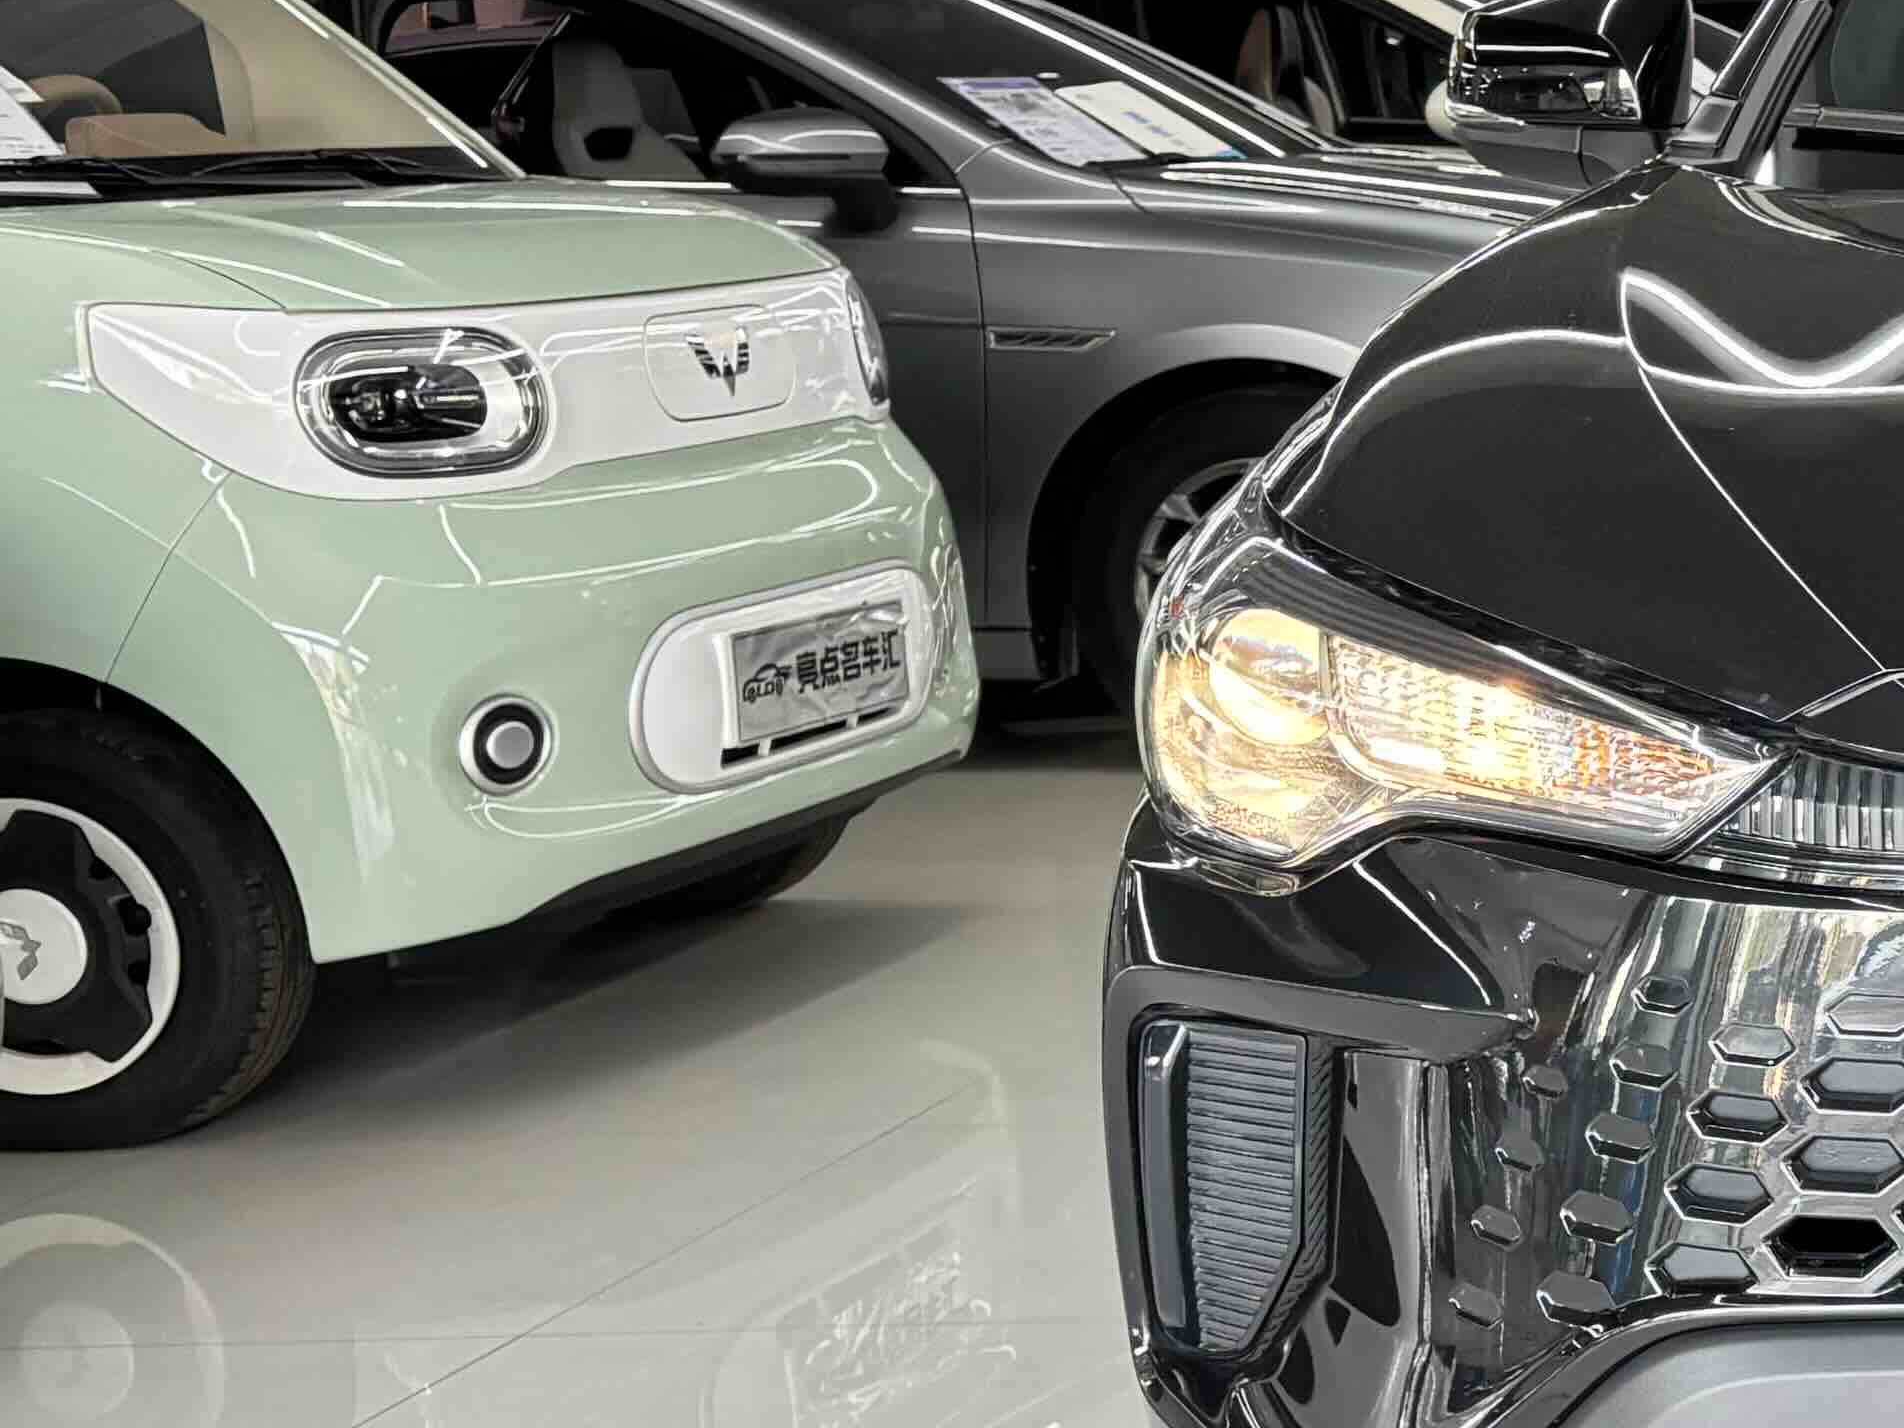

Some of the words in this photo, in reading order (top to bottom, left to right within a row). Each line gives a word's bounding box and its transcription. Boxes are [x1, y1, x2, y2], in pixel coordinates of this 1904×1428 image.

[795, 627, 901, 694] 亮点名车汇
